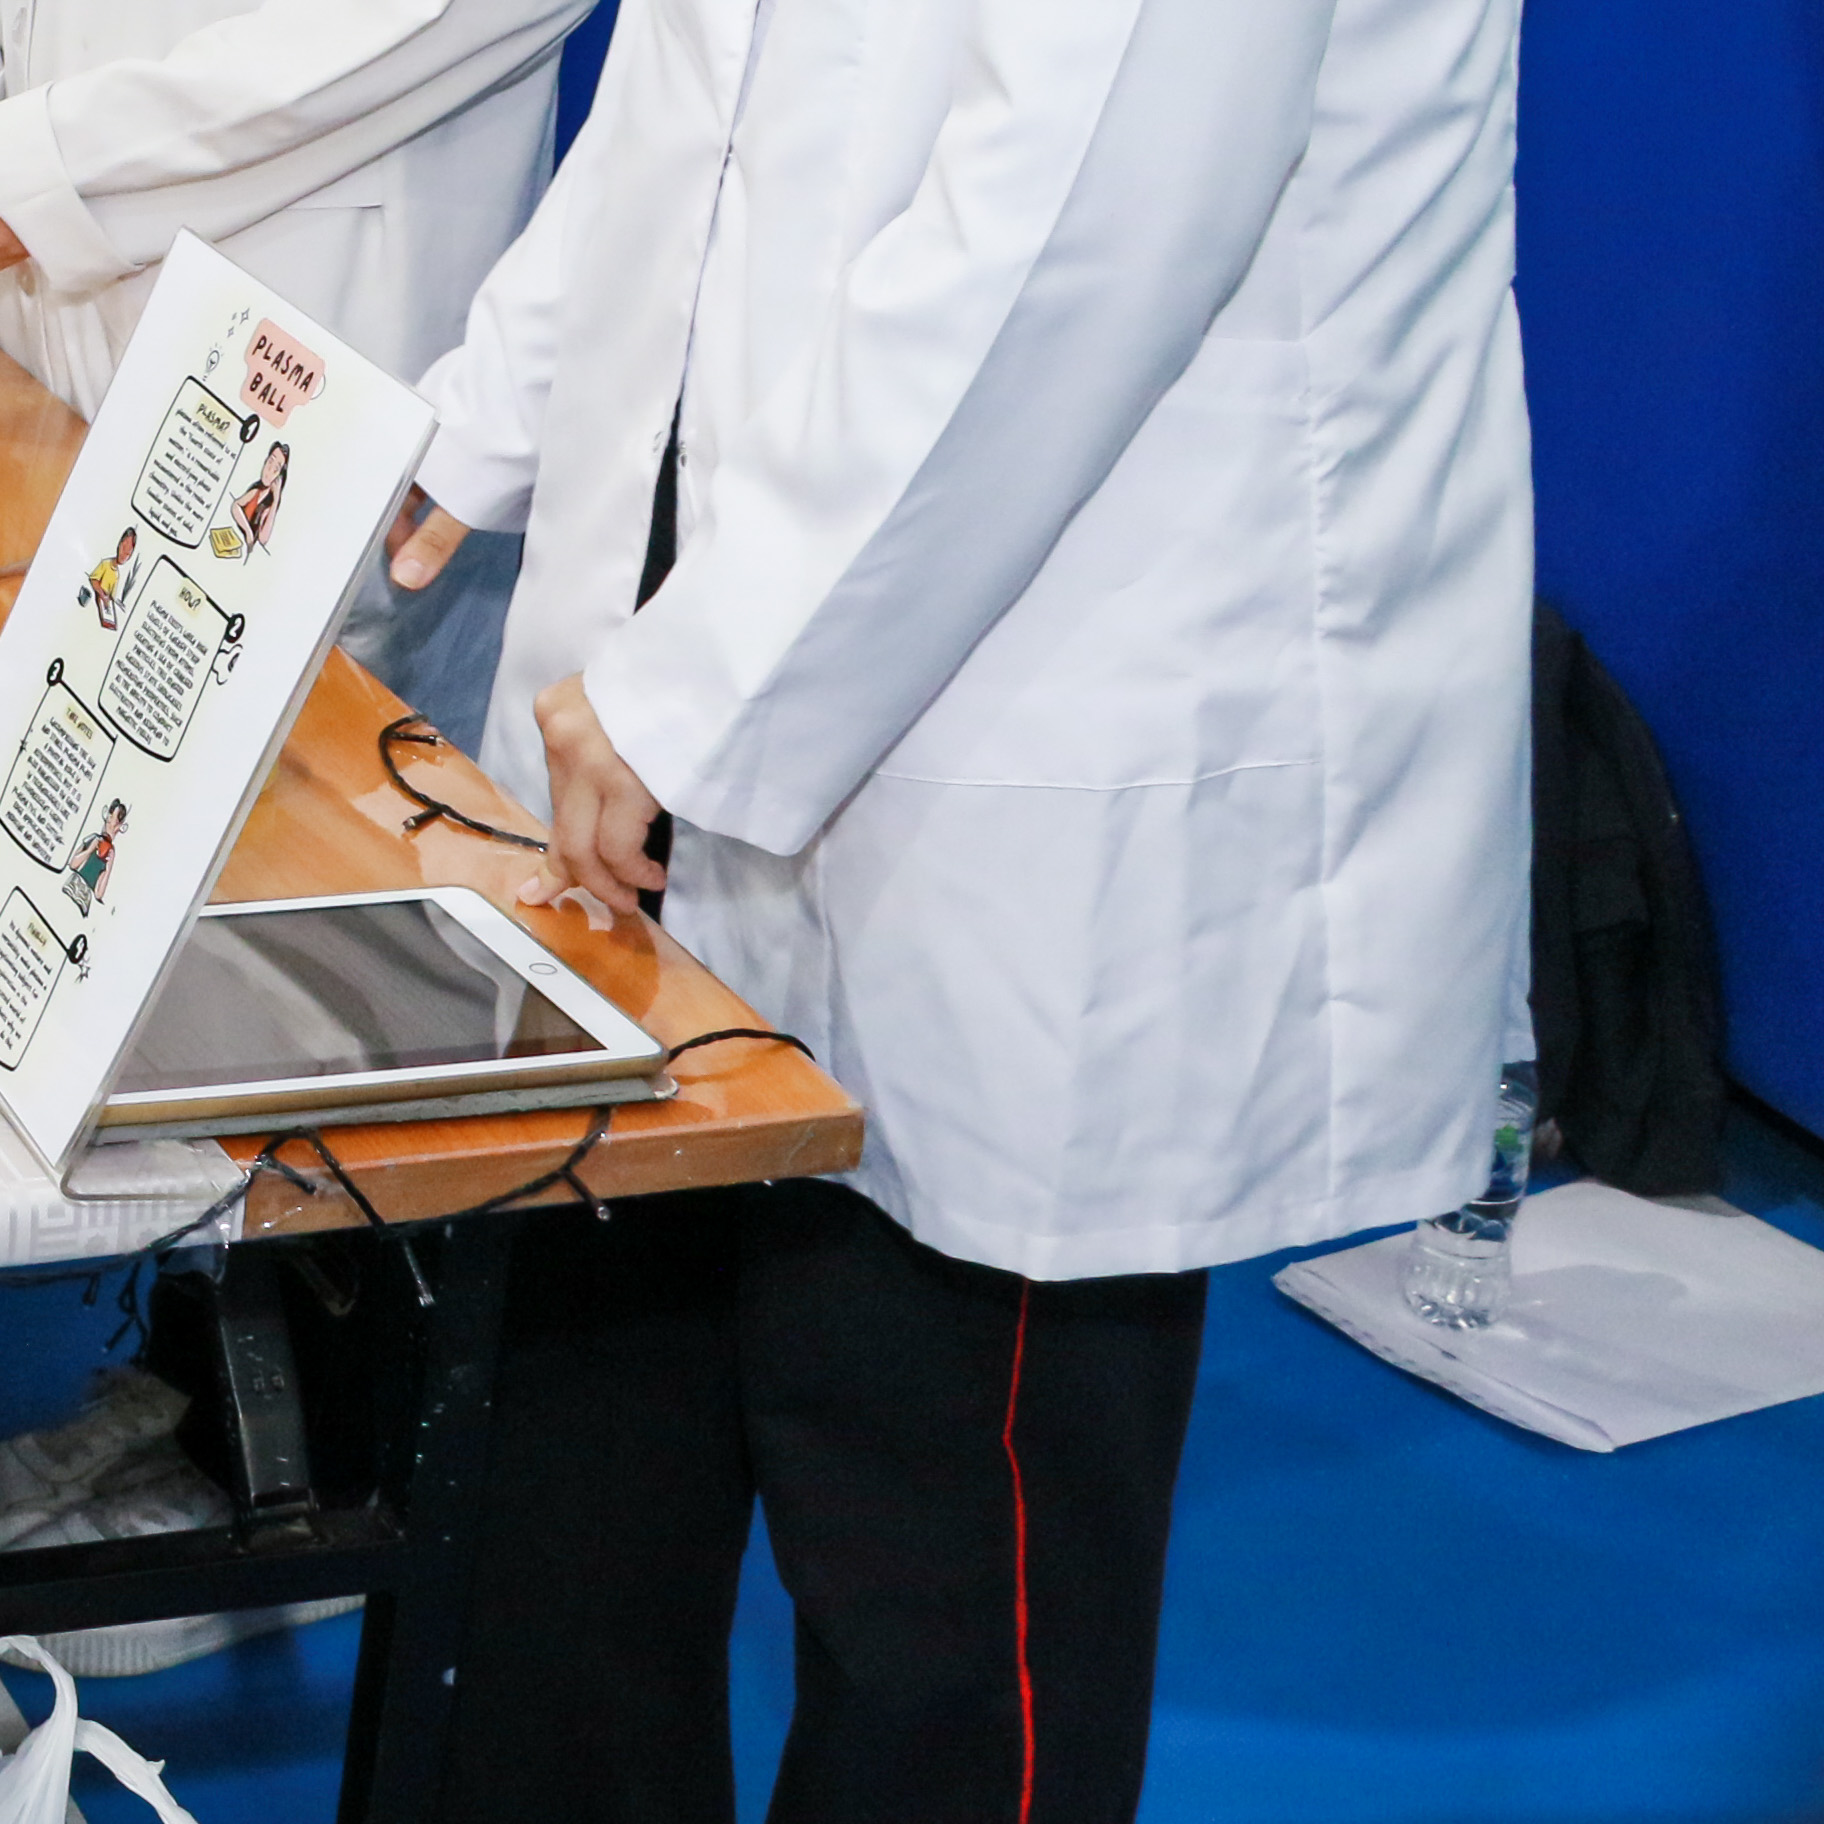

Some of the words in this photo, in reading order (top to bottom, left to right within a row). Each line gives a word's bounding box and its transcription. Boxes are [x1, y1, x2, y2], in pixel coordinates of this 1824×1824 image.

[252, 335, 313, 391] PLASMA
[249, 372, 285, 412] BALL
[196, 403, 230, 432] PLASMA?
[179, 587, 201, 609] HOW?
